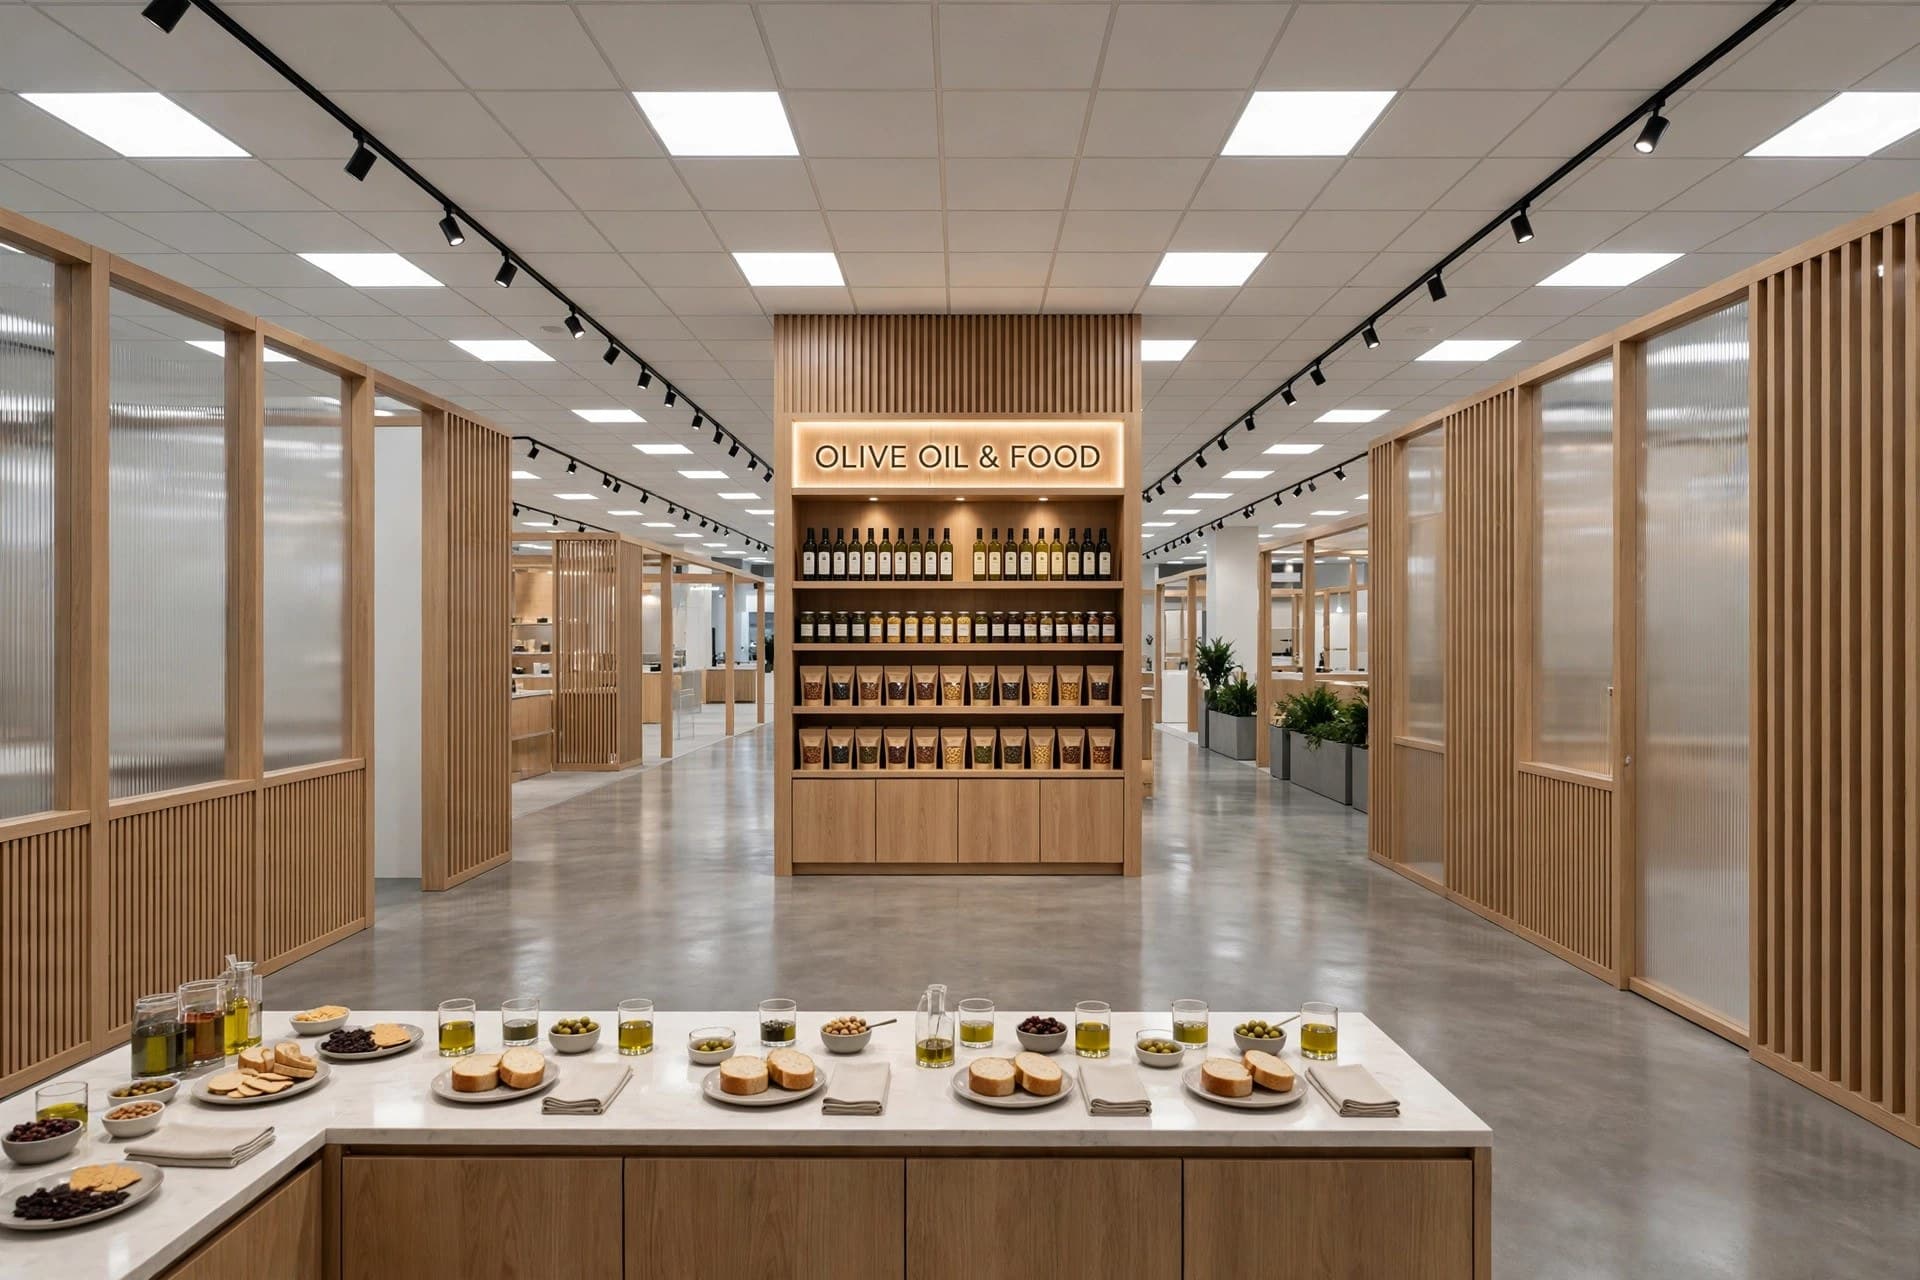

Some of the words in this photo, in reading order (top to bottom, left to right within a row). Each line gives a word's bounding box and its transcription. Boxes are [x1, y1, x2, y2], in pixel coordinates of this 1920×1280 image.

[815, 445, 907, 468] OLIVE
[918, 444, 969, 468] OIL
[979, 445, 1000, 469] &
[1011, 444, 1101, 469] FOOD
